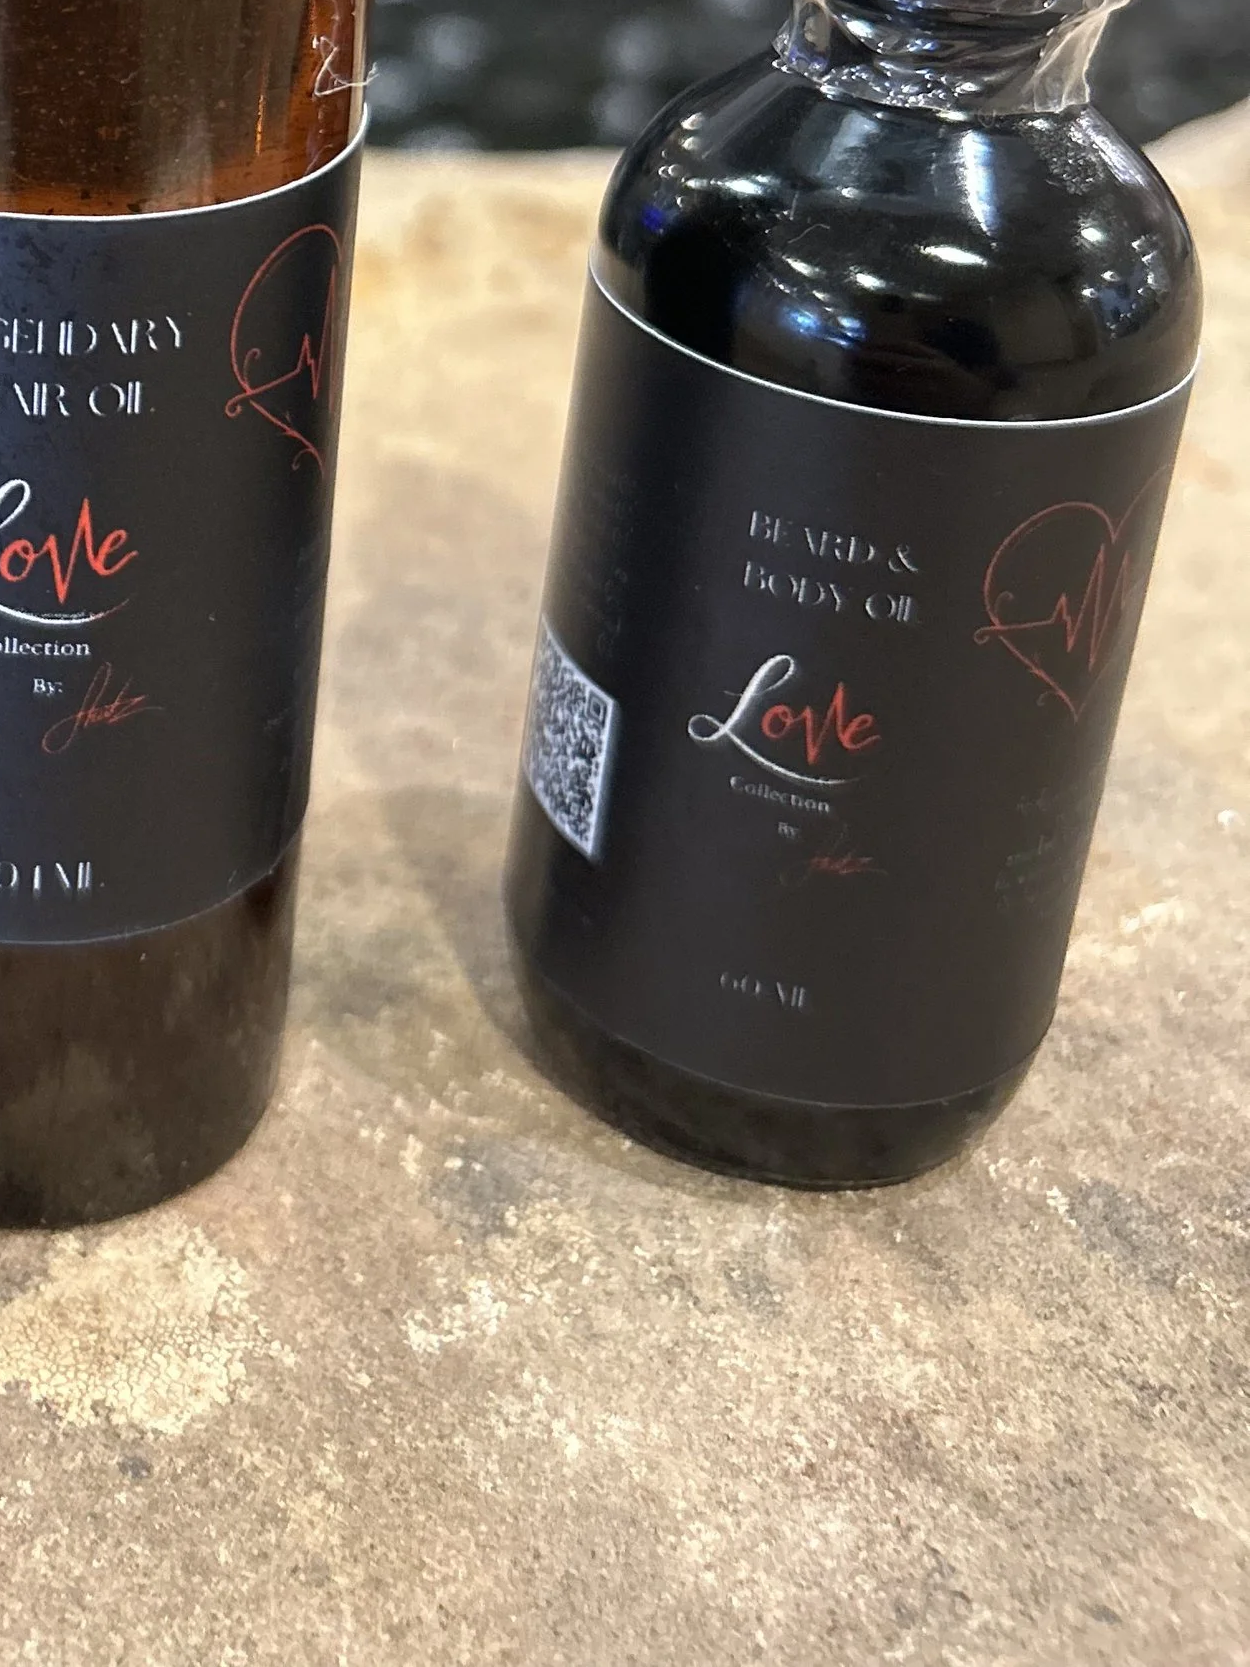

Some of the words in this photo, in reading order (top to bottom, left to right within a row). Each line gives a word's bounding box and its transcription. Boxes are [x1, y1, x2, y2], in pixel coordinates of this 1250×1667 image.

[749, 510, 876, 563] BEARD
[887, 544, 919, 573] &
[743, 561, 853, 614] BODY
[687, 654, 883, 786] Love
[729, 775, 831, 815] Collection
